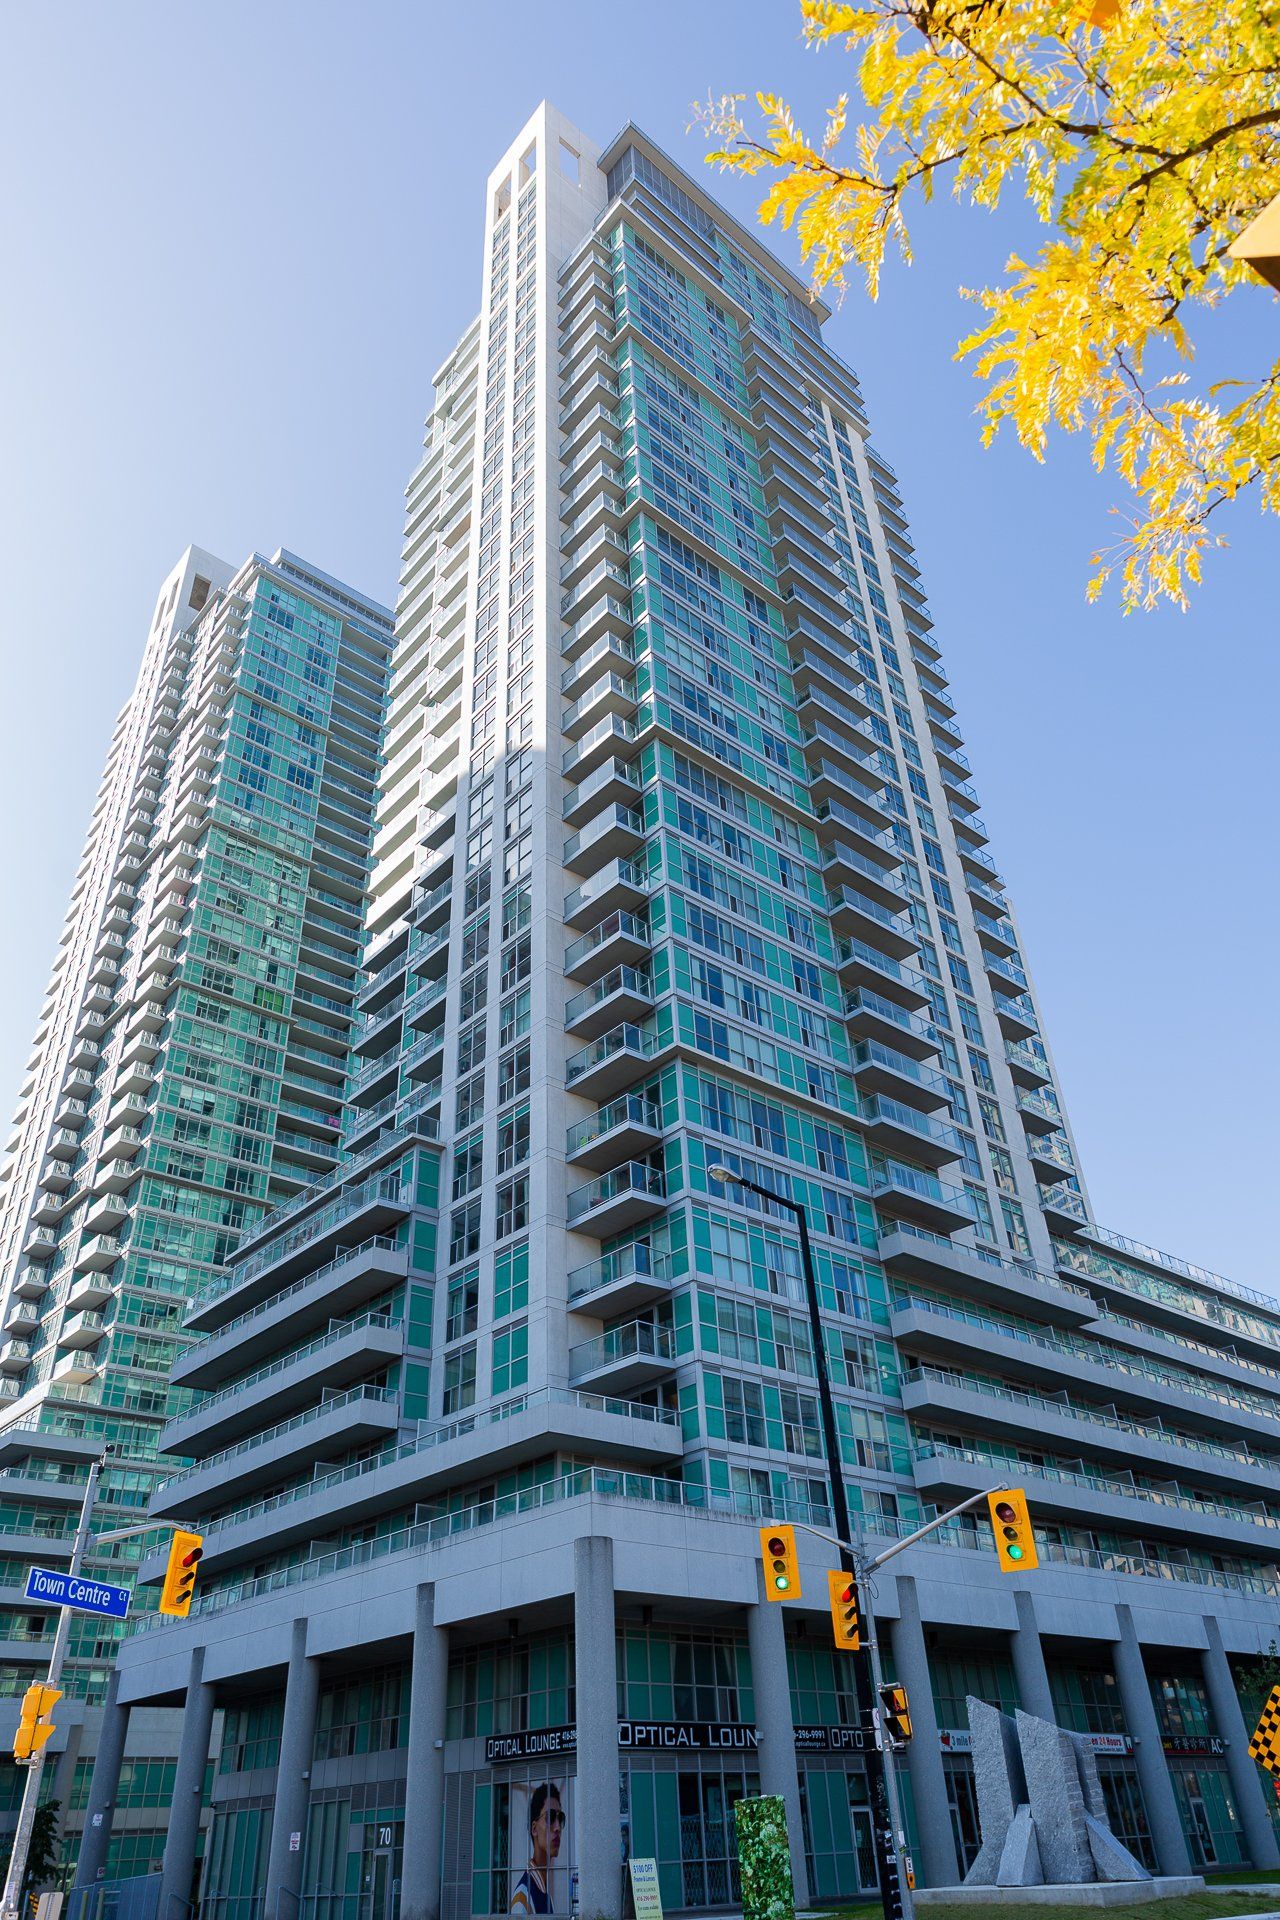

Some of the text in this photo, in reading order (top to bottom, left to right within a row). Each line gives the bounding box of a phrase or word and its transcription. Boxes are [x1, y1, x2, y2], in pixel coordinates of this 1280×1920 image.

[33, 1571, 127, 1606] Town Centre Ct
[618, 1723, 701, 1746] OPTICAL
[1098, 1736, 1106, 1745] 24
[1106, 1736, 1122, 1746] Hours
[488, 1732, 561, 1758] OPTICAL LOUNGE
[379, 1827, 391, 1845] 70
[645, 1864, 653, 1872] OFF
